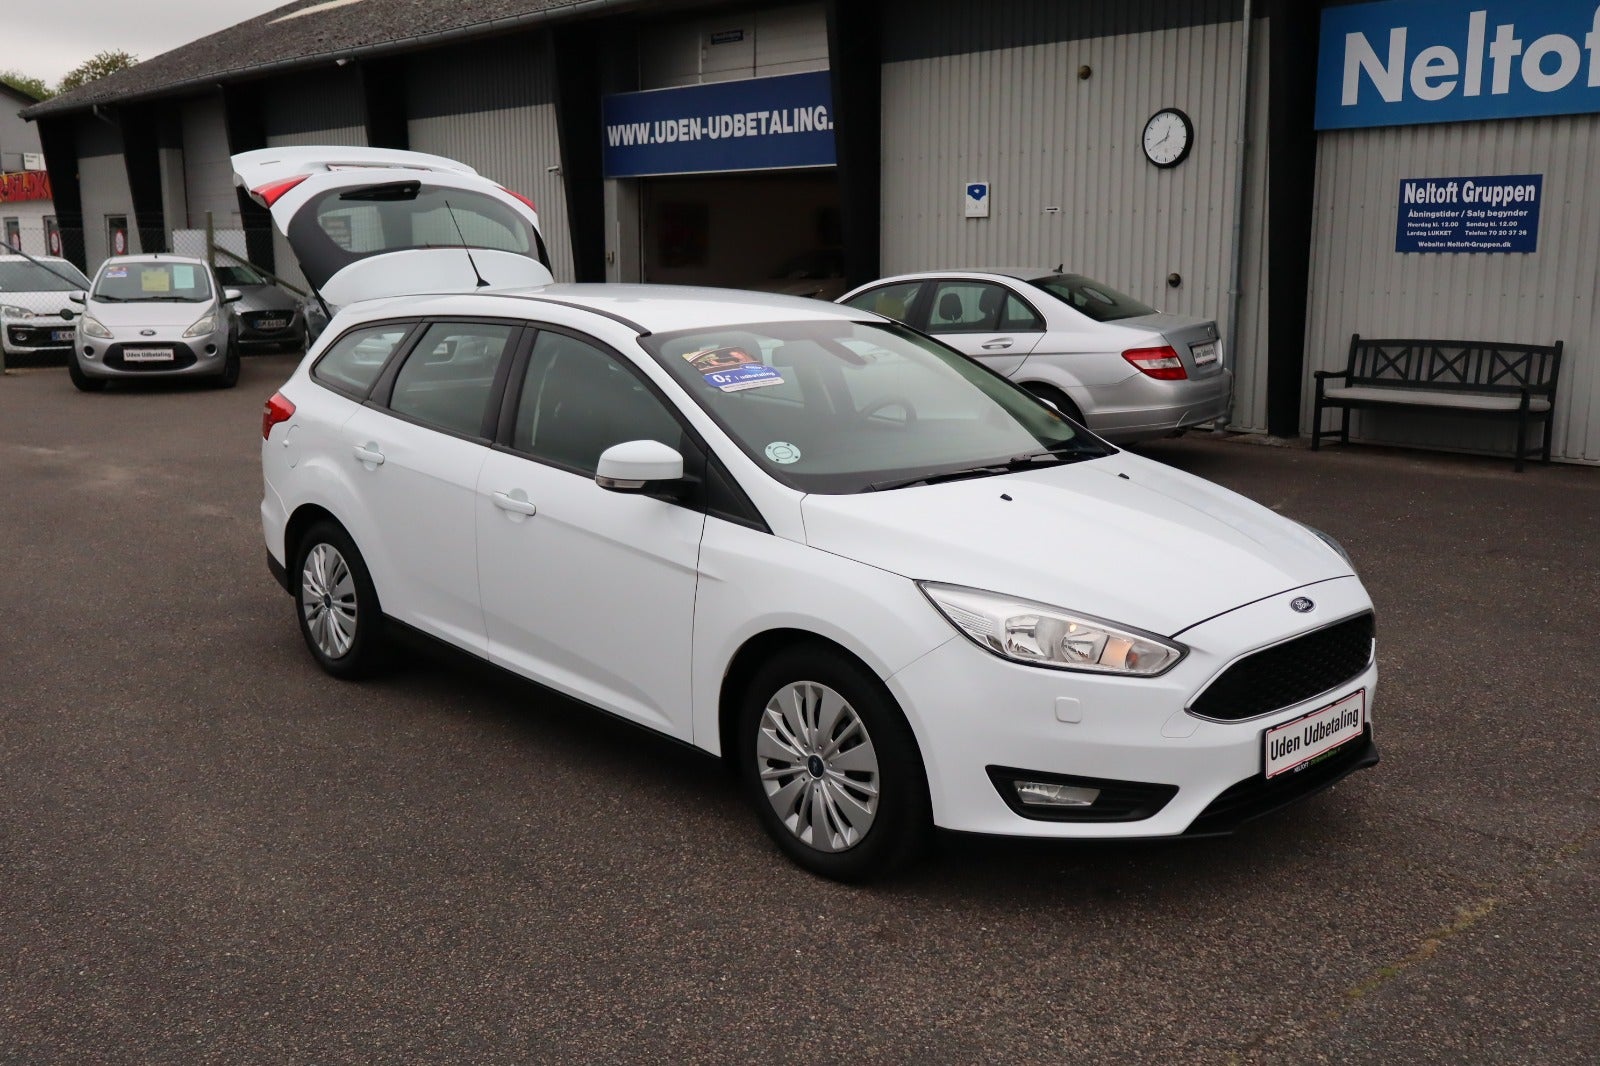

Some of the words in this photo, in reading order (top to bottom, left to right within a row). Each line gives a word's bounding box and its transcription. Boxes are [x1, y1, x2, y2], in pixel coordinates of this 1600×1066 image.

[1404, 182, 1458, 204] Neltoft
[1462, 181, 1536, 206] Gruppen
[1408, 209, 1459, 218] Åbningstider
[1460, 210, 1465, 218] /
[1467, 210, 1485, 218] Salg
[1487, 209, 1528, 218] begynder
[126, 350, 141, 358] Uden
[141, 350, 172, 359] Udbetaling
[1270, 735, 1300, 761] Uden
[1304, 708, 1359, 747] Udbetaling
